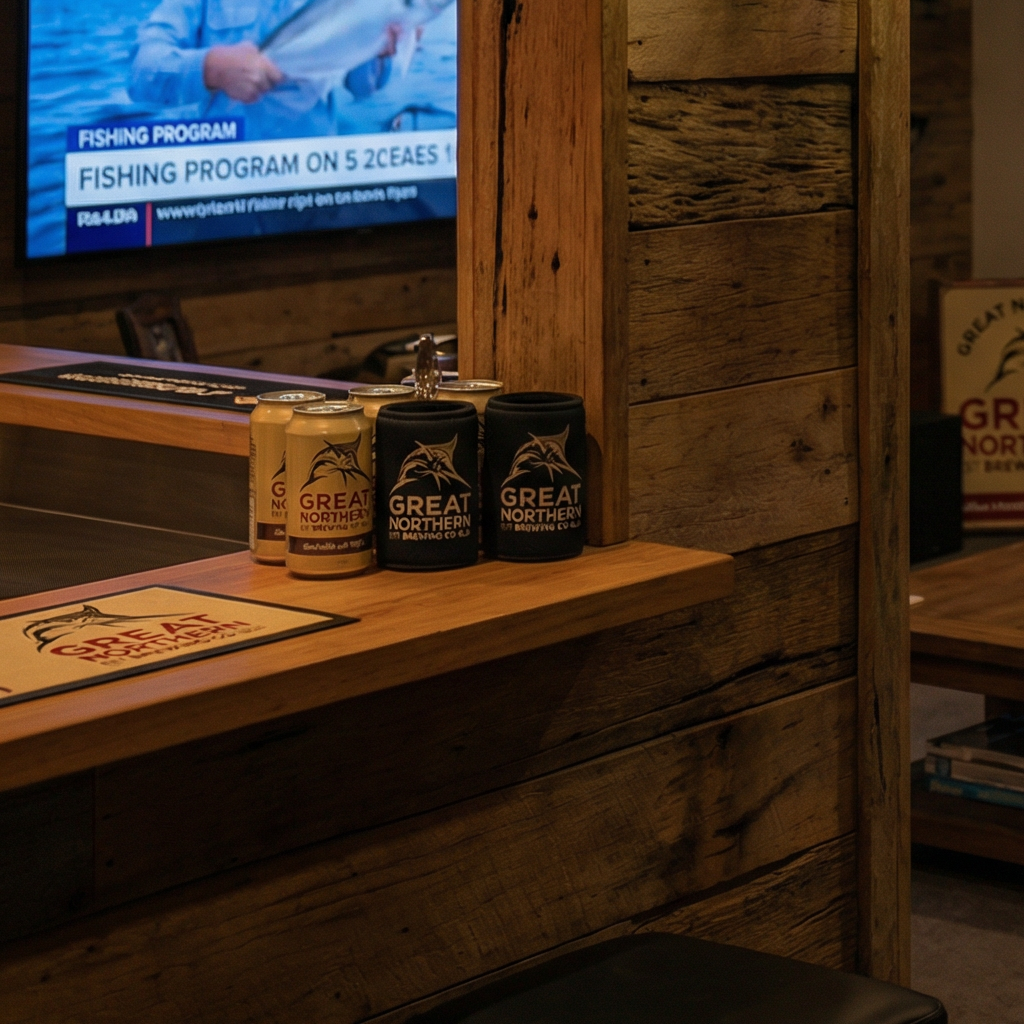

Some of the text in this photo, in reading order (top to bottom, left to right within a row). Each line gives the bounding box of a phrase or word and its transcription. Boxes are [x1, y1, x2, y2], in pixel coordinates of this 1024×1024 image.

[77, 122, 237, 149] FISHING PROGRAM
[79, 162, 178, 191] FISHING
[184, 153, 300, 183] PROGRAM
[306, 151, 339, 174] ON
[345, 149, 358, 171] 5
[956, 302, 1006, 357] GREAT
[299, 489, 370, 510] GREAT
[389, 493, 472, 516] GREAT
[501, 484, 582, 508] GREAT
[389, 514, 471, 531] NORTHERN
[501, 504, 583, 523] NORTHERN
[50, 614, 220, 657] GREAT
